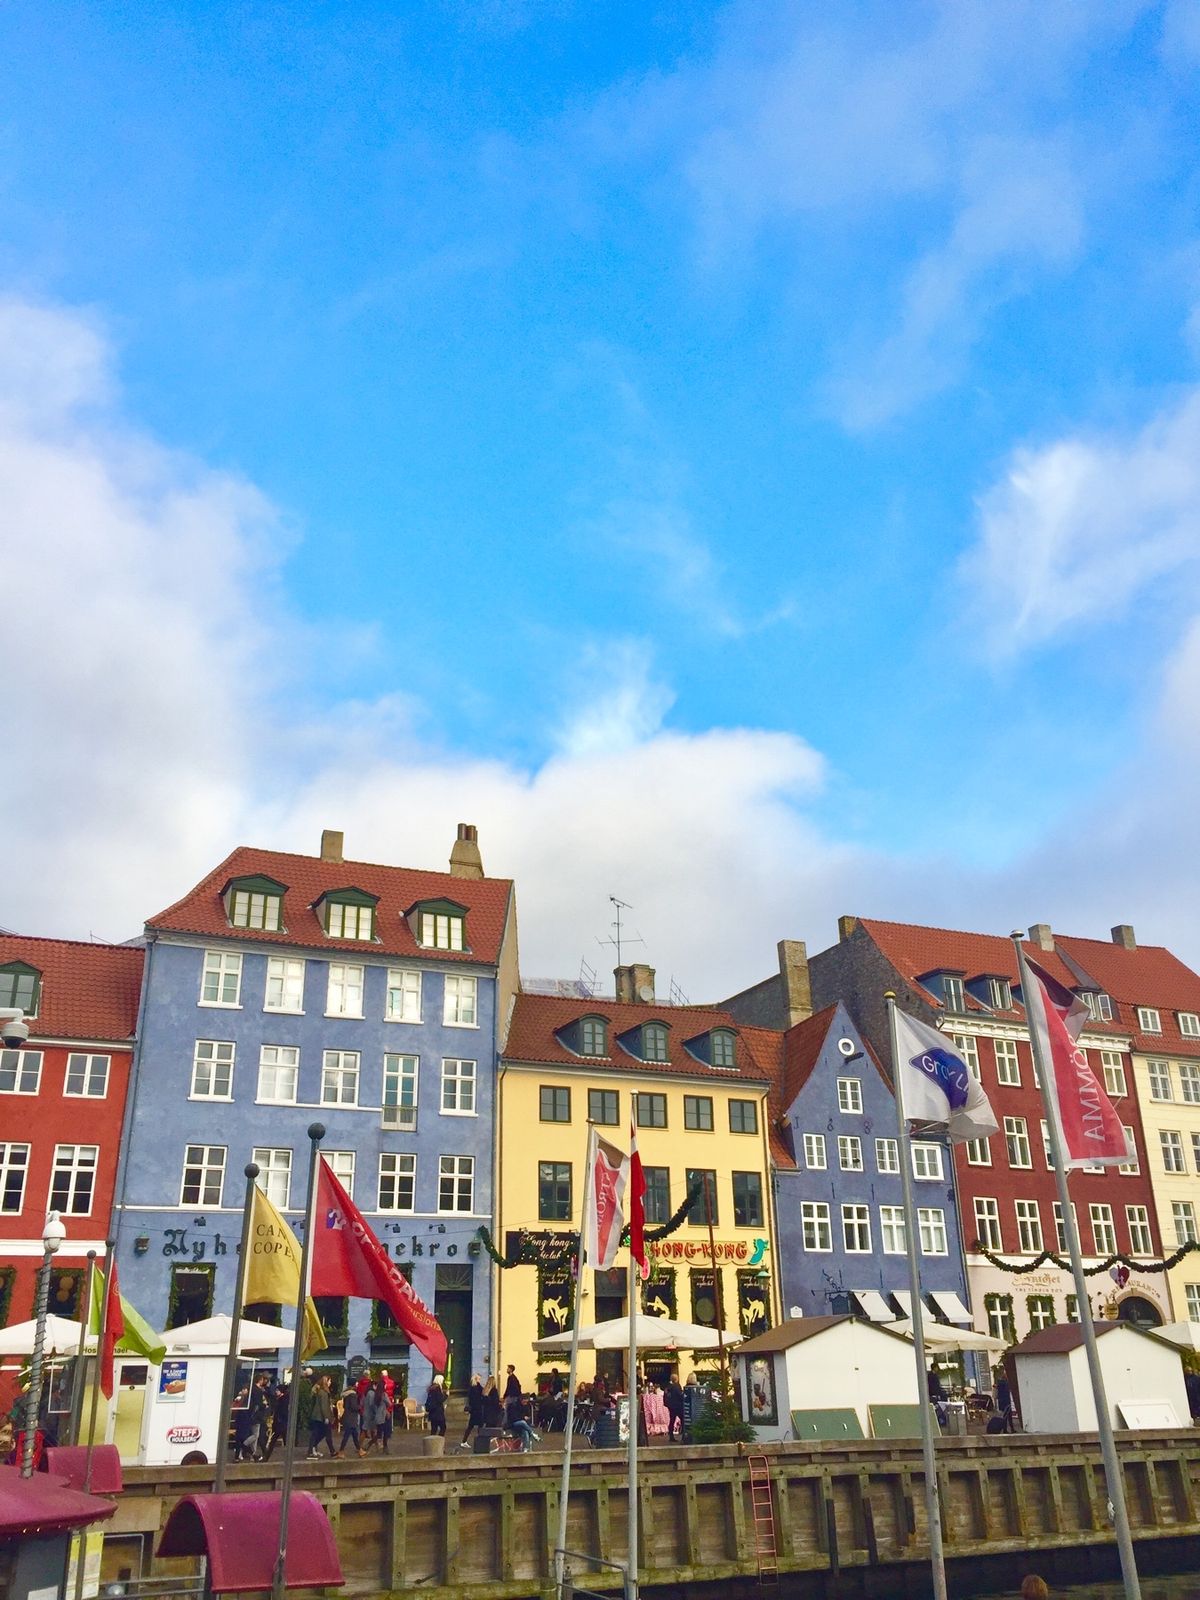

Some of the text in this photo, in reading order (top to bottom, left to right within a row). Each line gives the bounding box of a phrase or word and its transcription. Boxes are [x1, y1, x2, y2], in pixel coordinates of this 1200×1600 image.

[162, 1229, 240, 1262] Nyh
[253, 1241, 295, 1261] COPE
[407, 1305, 442, 1331] ursions
[172, 1428, 197, 1437] STEFF
